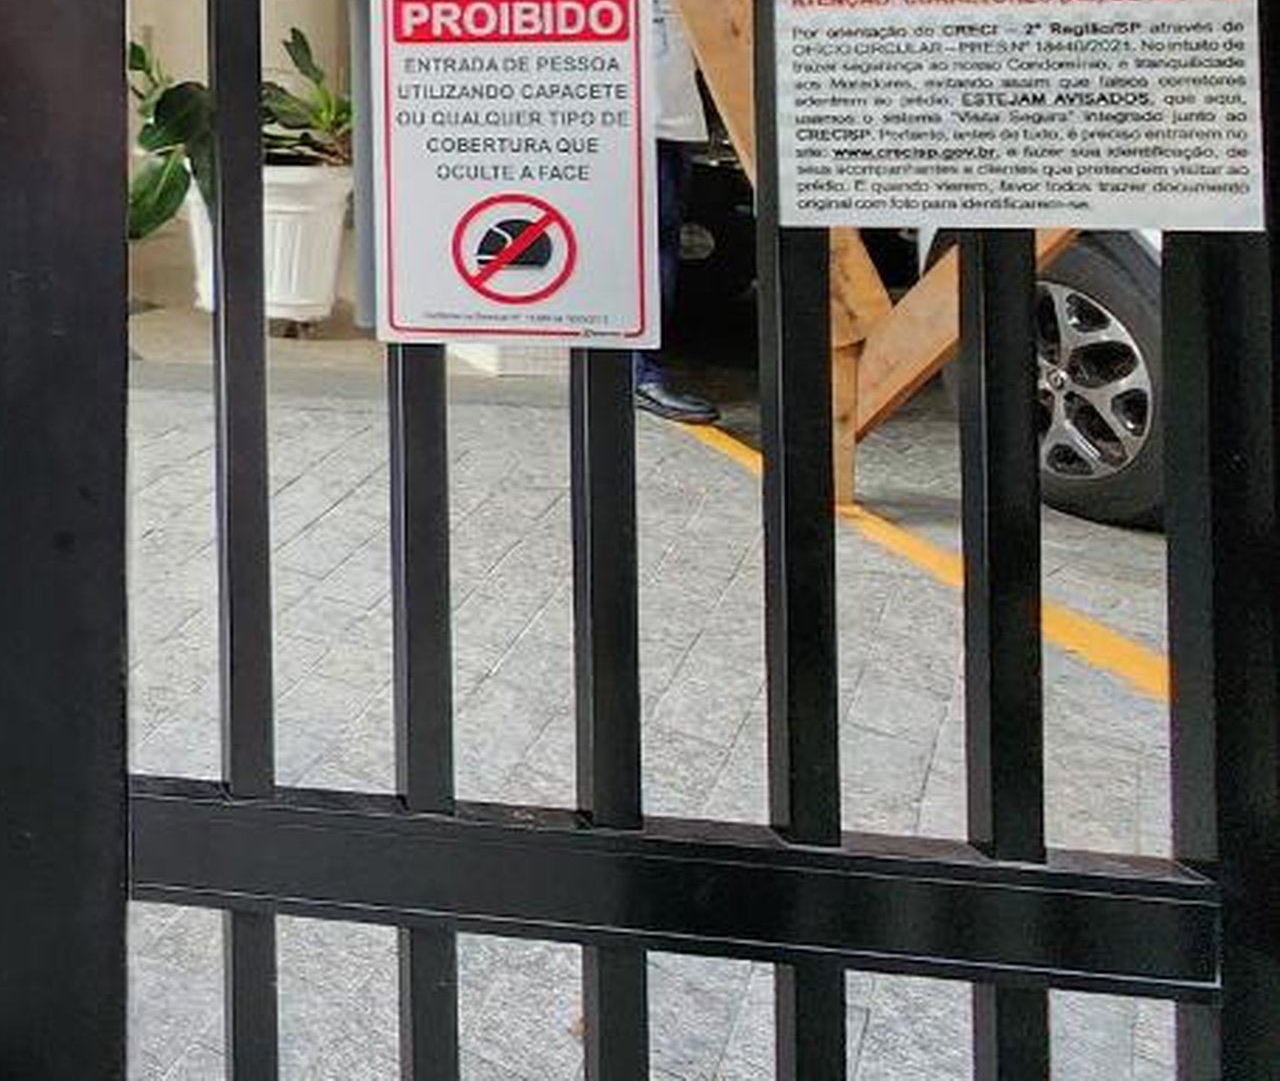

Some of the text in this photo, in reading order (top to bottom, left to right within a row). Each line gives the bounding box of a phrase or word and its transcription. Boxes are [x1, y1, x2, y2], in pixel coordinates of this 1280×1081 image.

[400, 0, 624, 37] PROIBIDO
[792, 27, 818, 39] Por
[914, 25, 934, 37] do
[942, 24, 997, 36] CRECI
[1222, 21, 1244, 33] de
[1222, 38, 1244, 51] de
[404, 55, 621, 74] ENTRADA DE PESSOA
[397, 84, 628, 100] UTILIZANDO CAPACETE
[396, 110, 630, 129] OU QUALQUER TIPO DE
[426, 137, 599, 154] COBERTURA QUE
[437, 164, 590, 181] OCULTE A FACE
